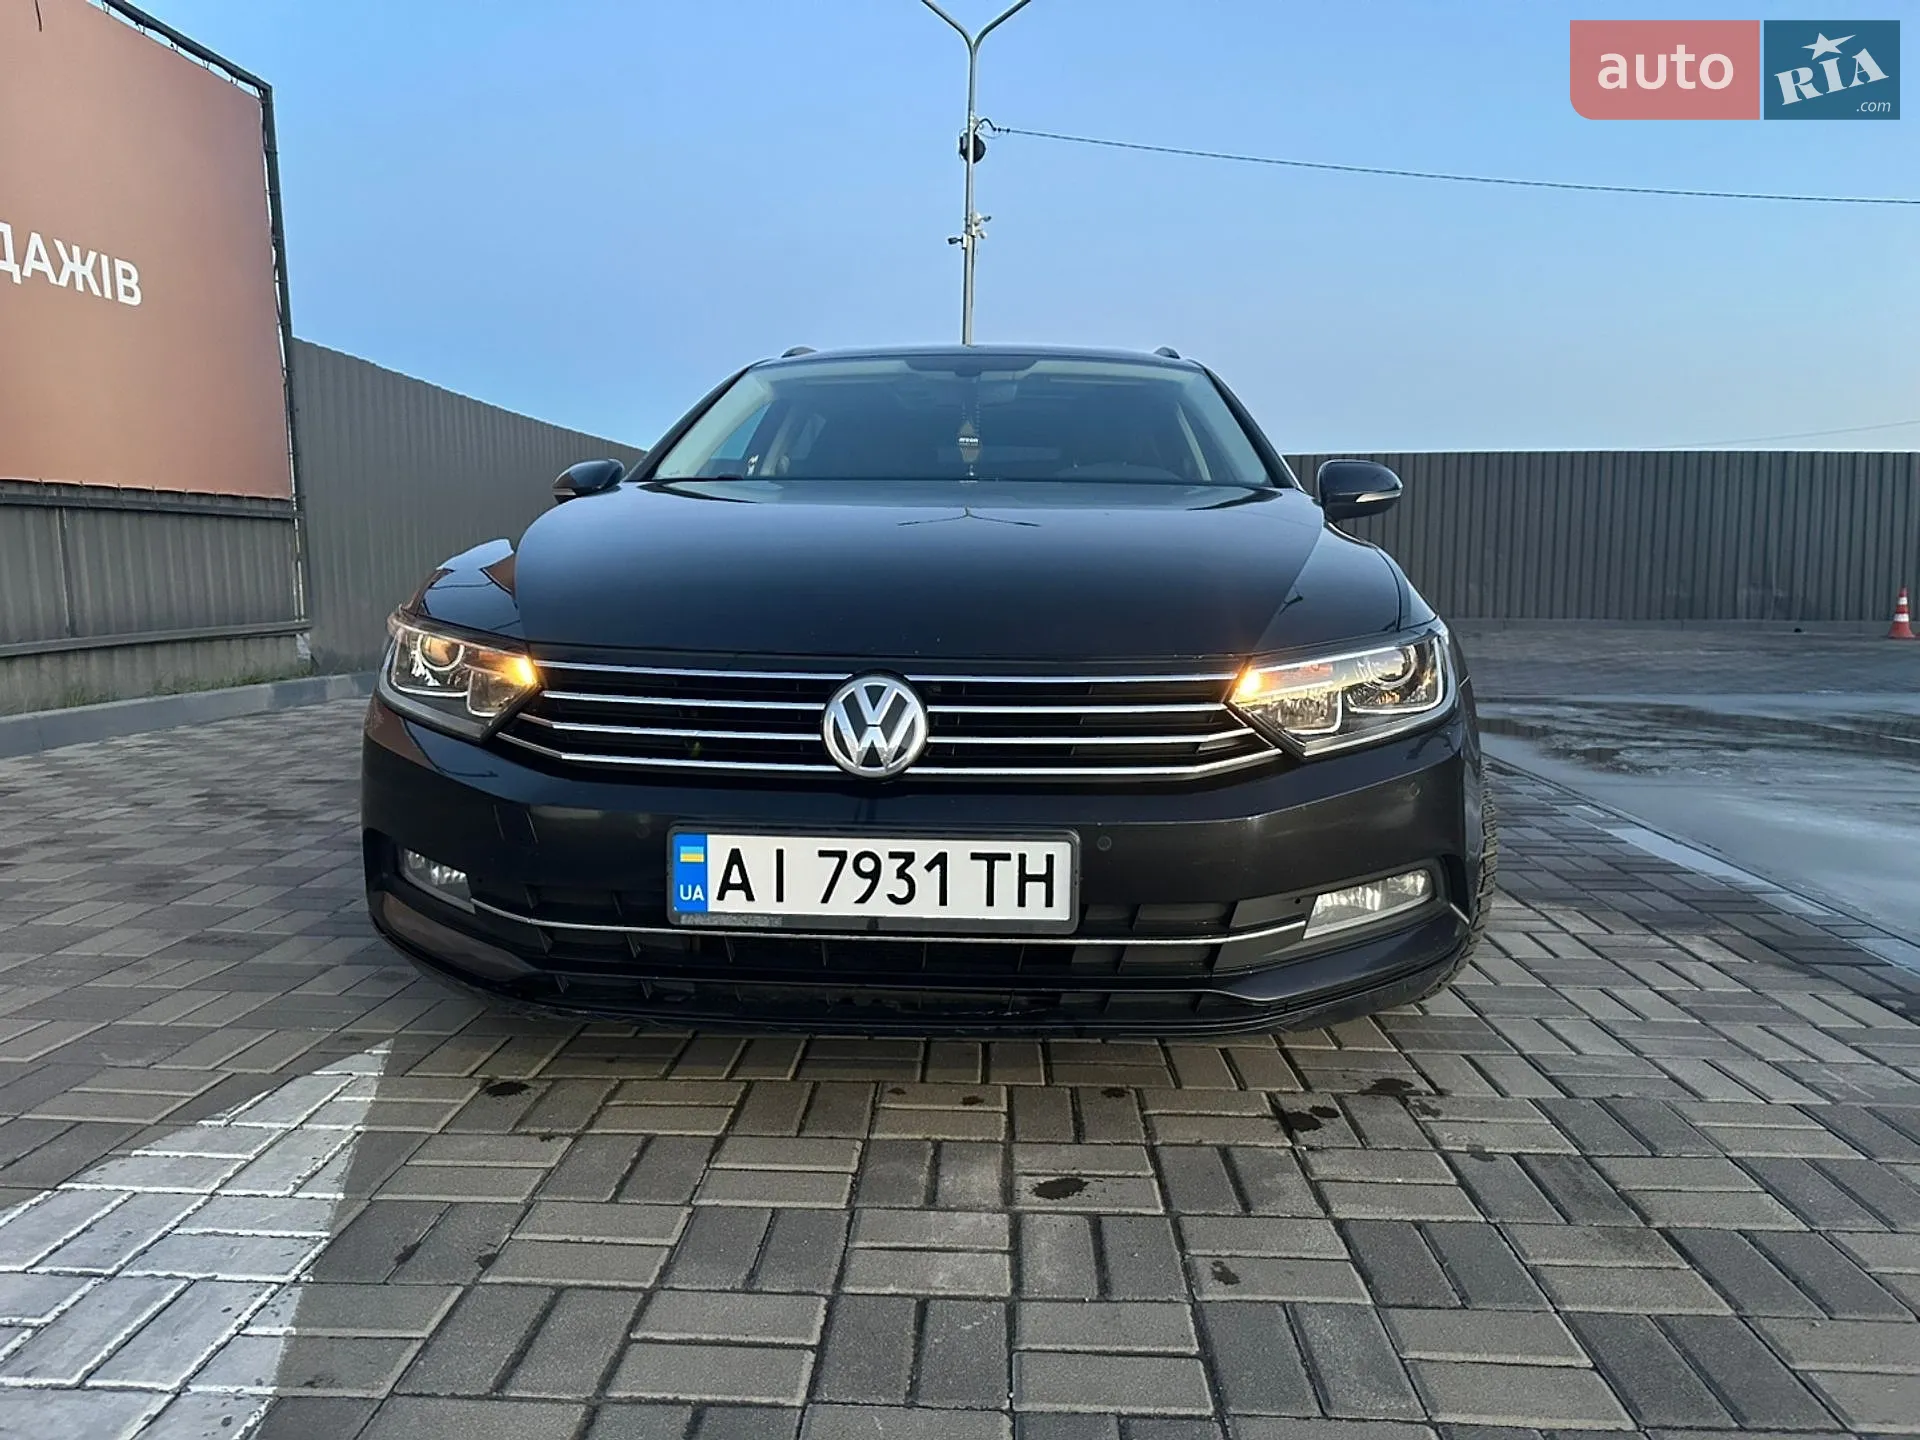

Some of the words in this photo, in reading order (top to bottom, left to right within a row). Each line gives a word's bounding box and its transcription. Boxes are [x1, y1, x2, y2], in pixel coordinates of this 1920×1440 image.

[679, 884, 705, 901] UA
[716, 848, 785, 903] AI
[817, 850, 949, 907] 7931
[970, 852, 1055, 908] TH
